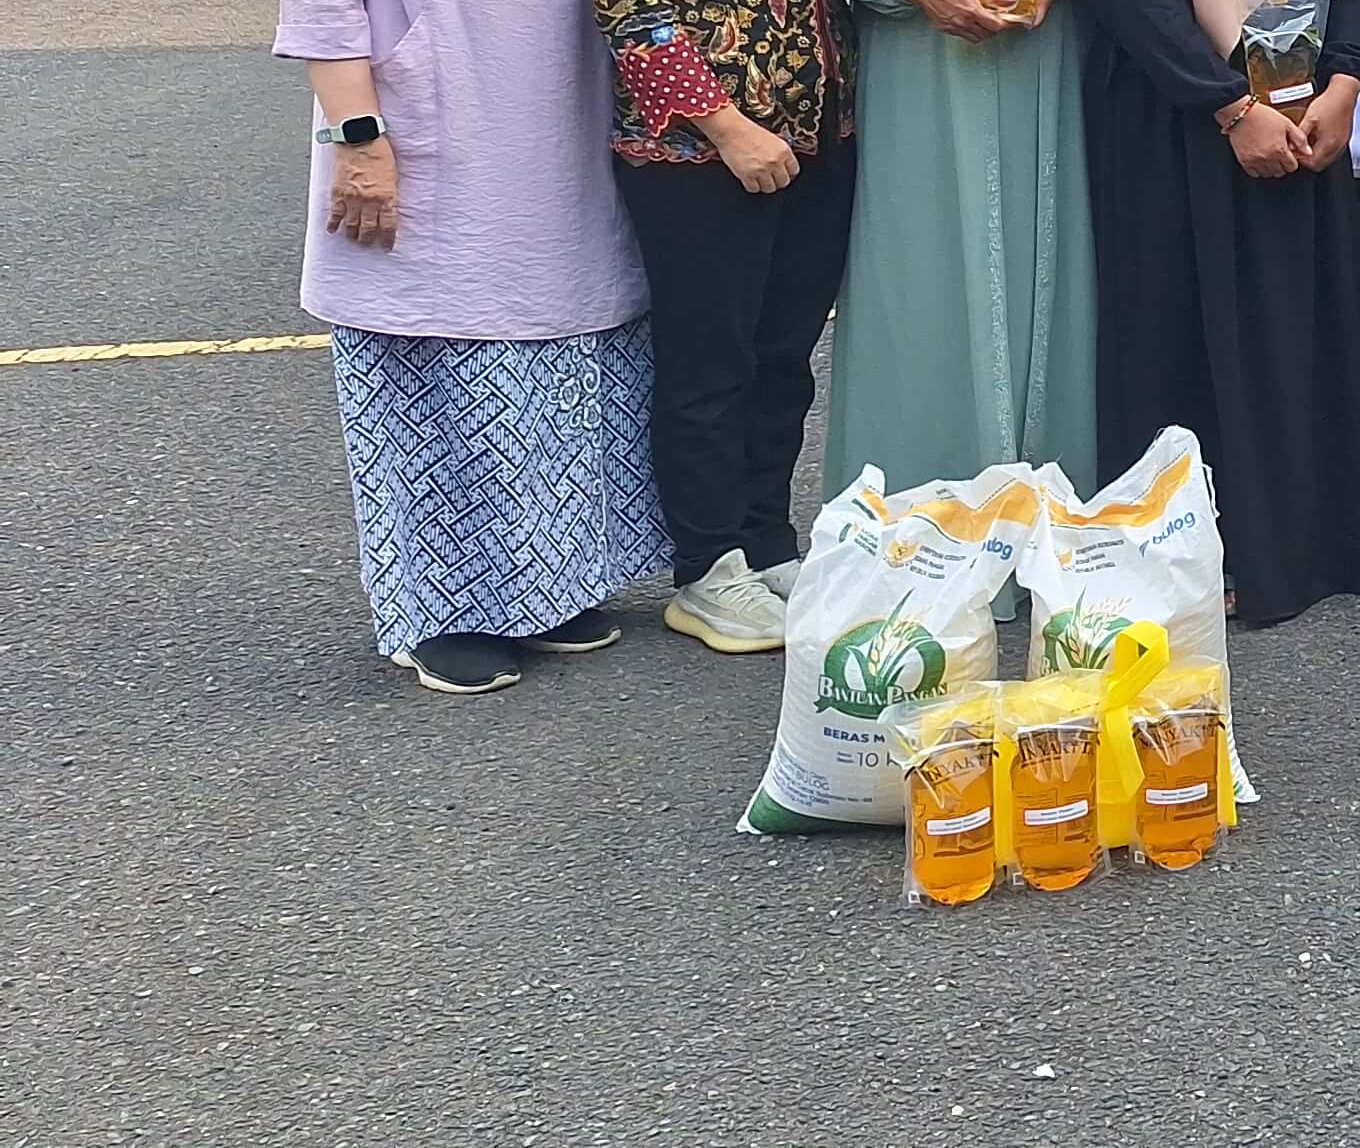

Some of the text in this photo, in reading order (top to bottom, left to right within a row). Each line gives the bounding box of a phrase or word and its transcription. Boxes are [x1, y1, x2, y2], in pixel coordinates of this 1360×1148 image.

[1152, 512, 1196, 544] bulog
[823, 727, 870, 743] BERAS
[857, 752, 879, 768] 10
